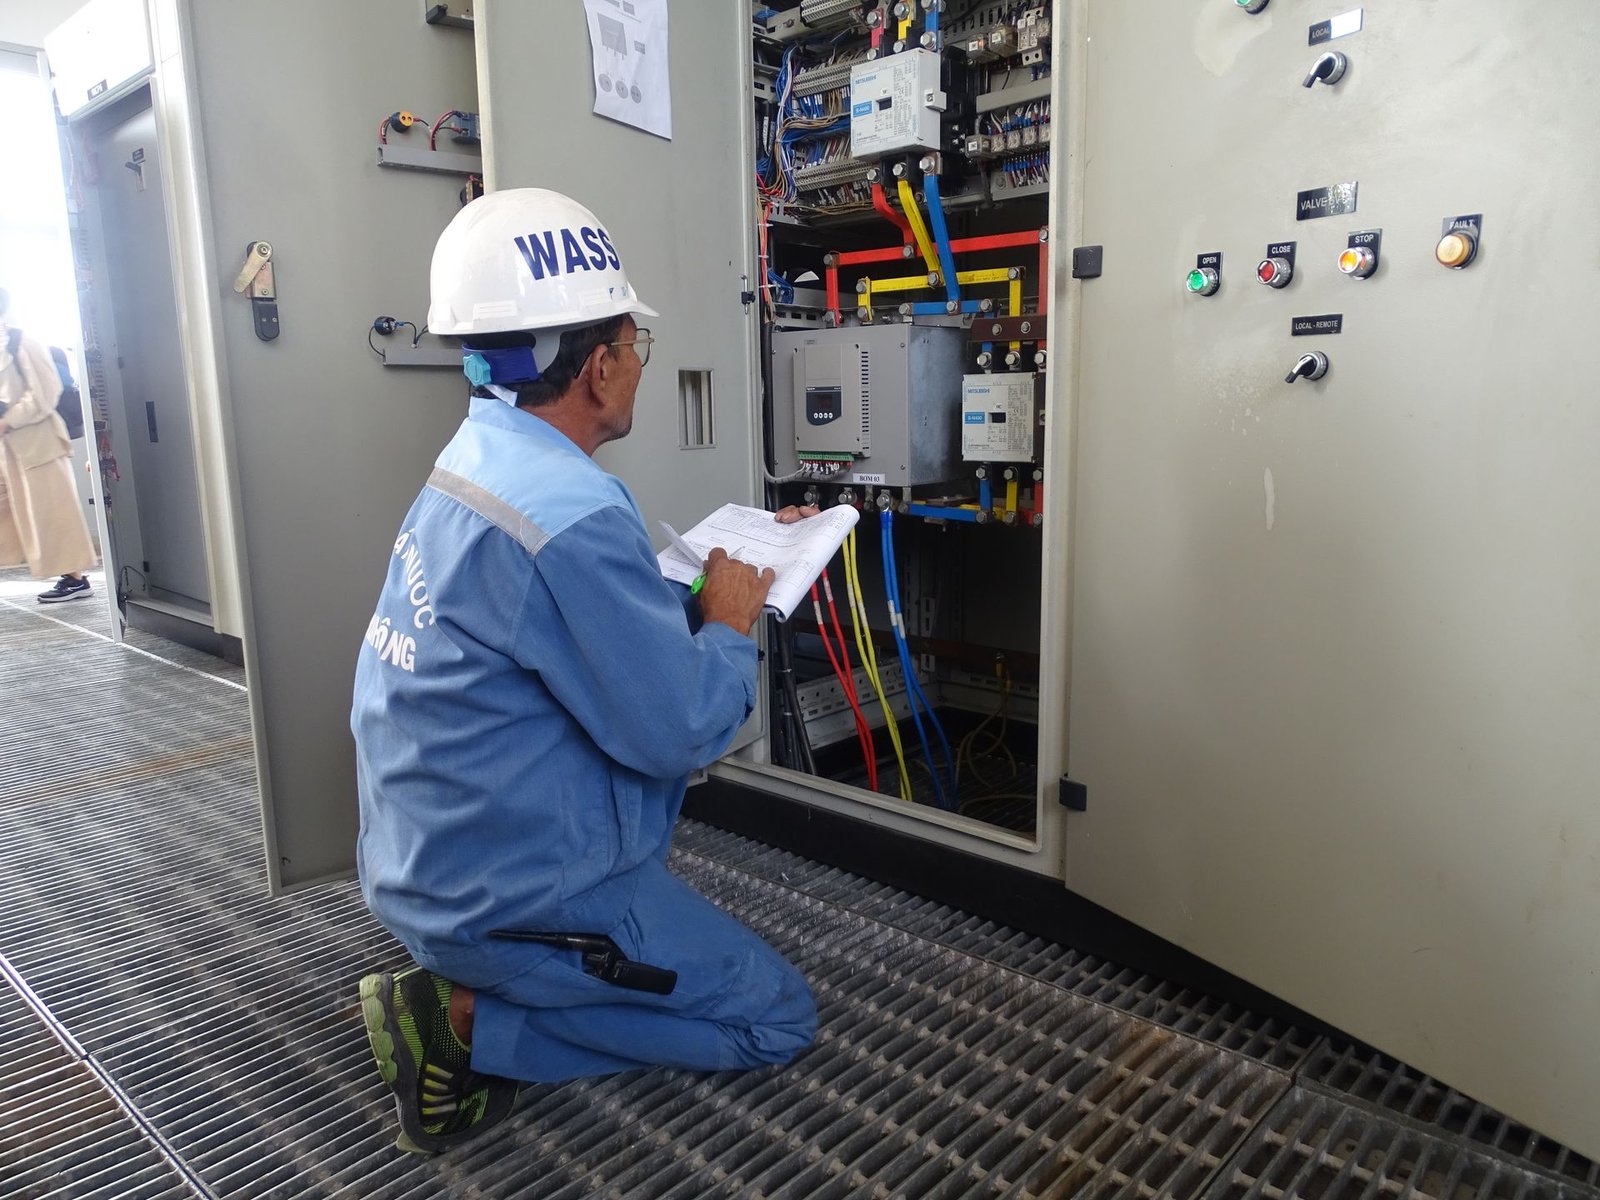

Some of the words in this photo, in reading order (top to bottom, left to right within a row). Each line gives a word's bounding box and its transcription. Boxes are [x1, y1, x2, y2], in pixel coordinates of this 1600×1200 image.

[1301, 197, 1327, 211] VALVE
[1449, 219, 1475, 230] FAULT
[1355, 233, 1375, 244] STOP
[1271, 245, 1291, 254] CLOSE
[1202, 256, 1217, 265] OPEN
[1295, 322, 1312, 330] LOCAL
[1316, 320, 1338, 329] REMOTE
